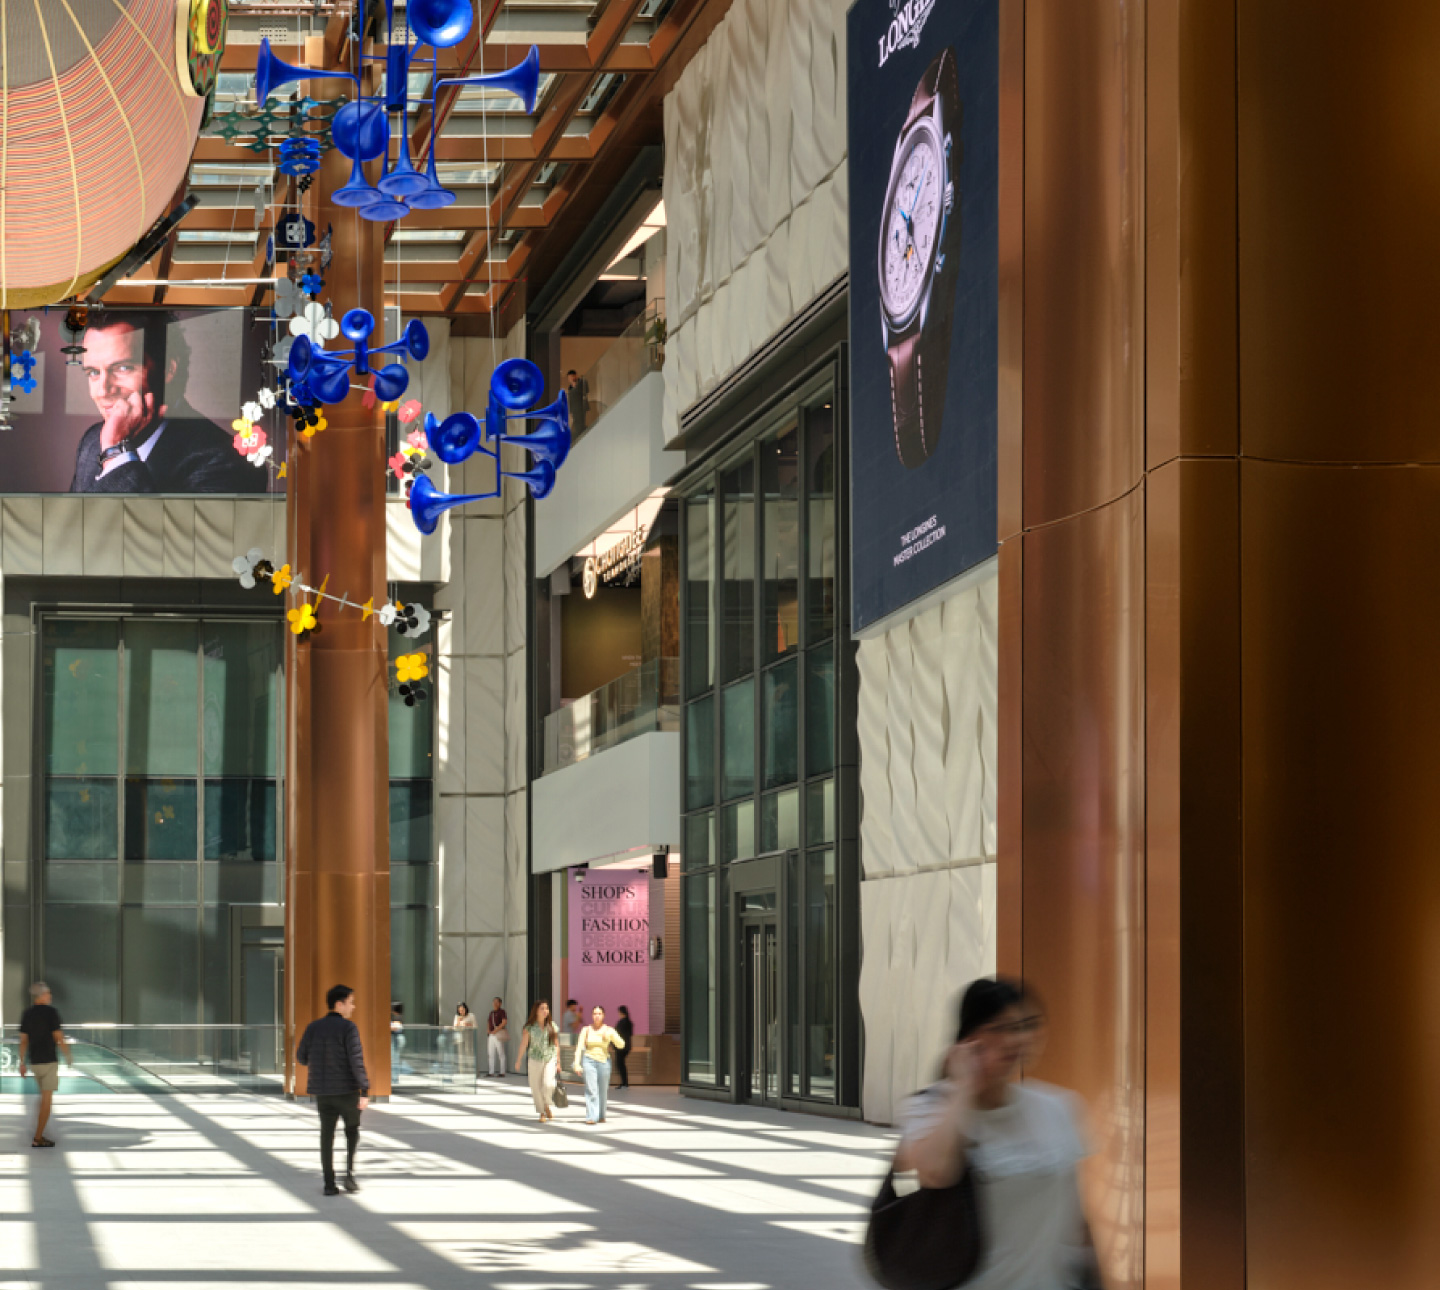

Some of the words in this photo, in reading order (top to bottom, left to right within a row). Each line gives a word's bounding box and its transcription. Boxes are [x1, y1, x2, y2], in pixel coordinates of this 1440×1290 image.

[581, 886, 635, 899] SHOPS
[582, 951, 593, 963] &
[597, 951, 645, 963] MORE
